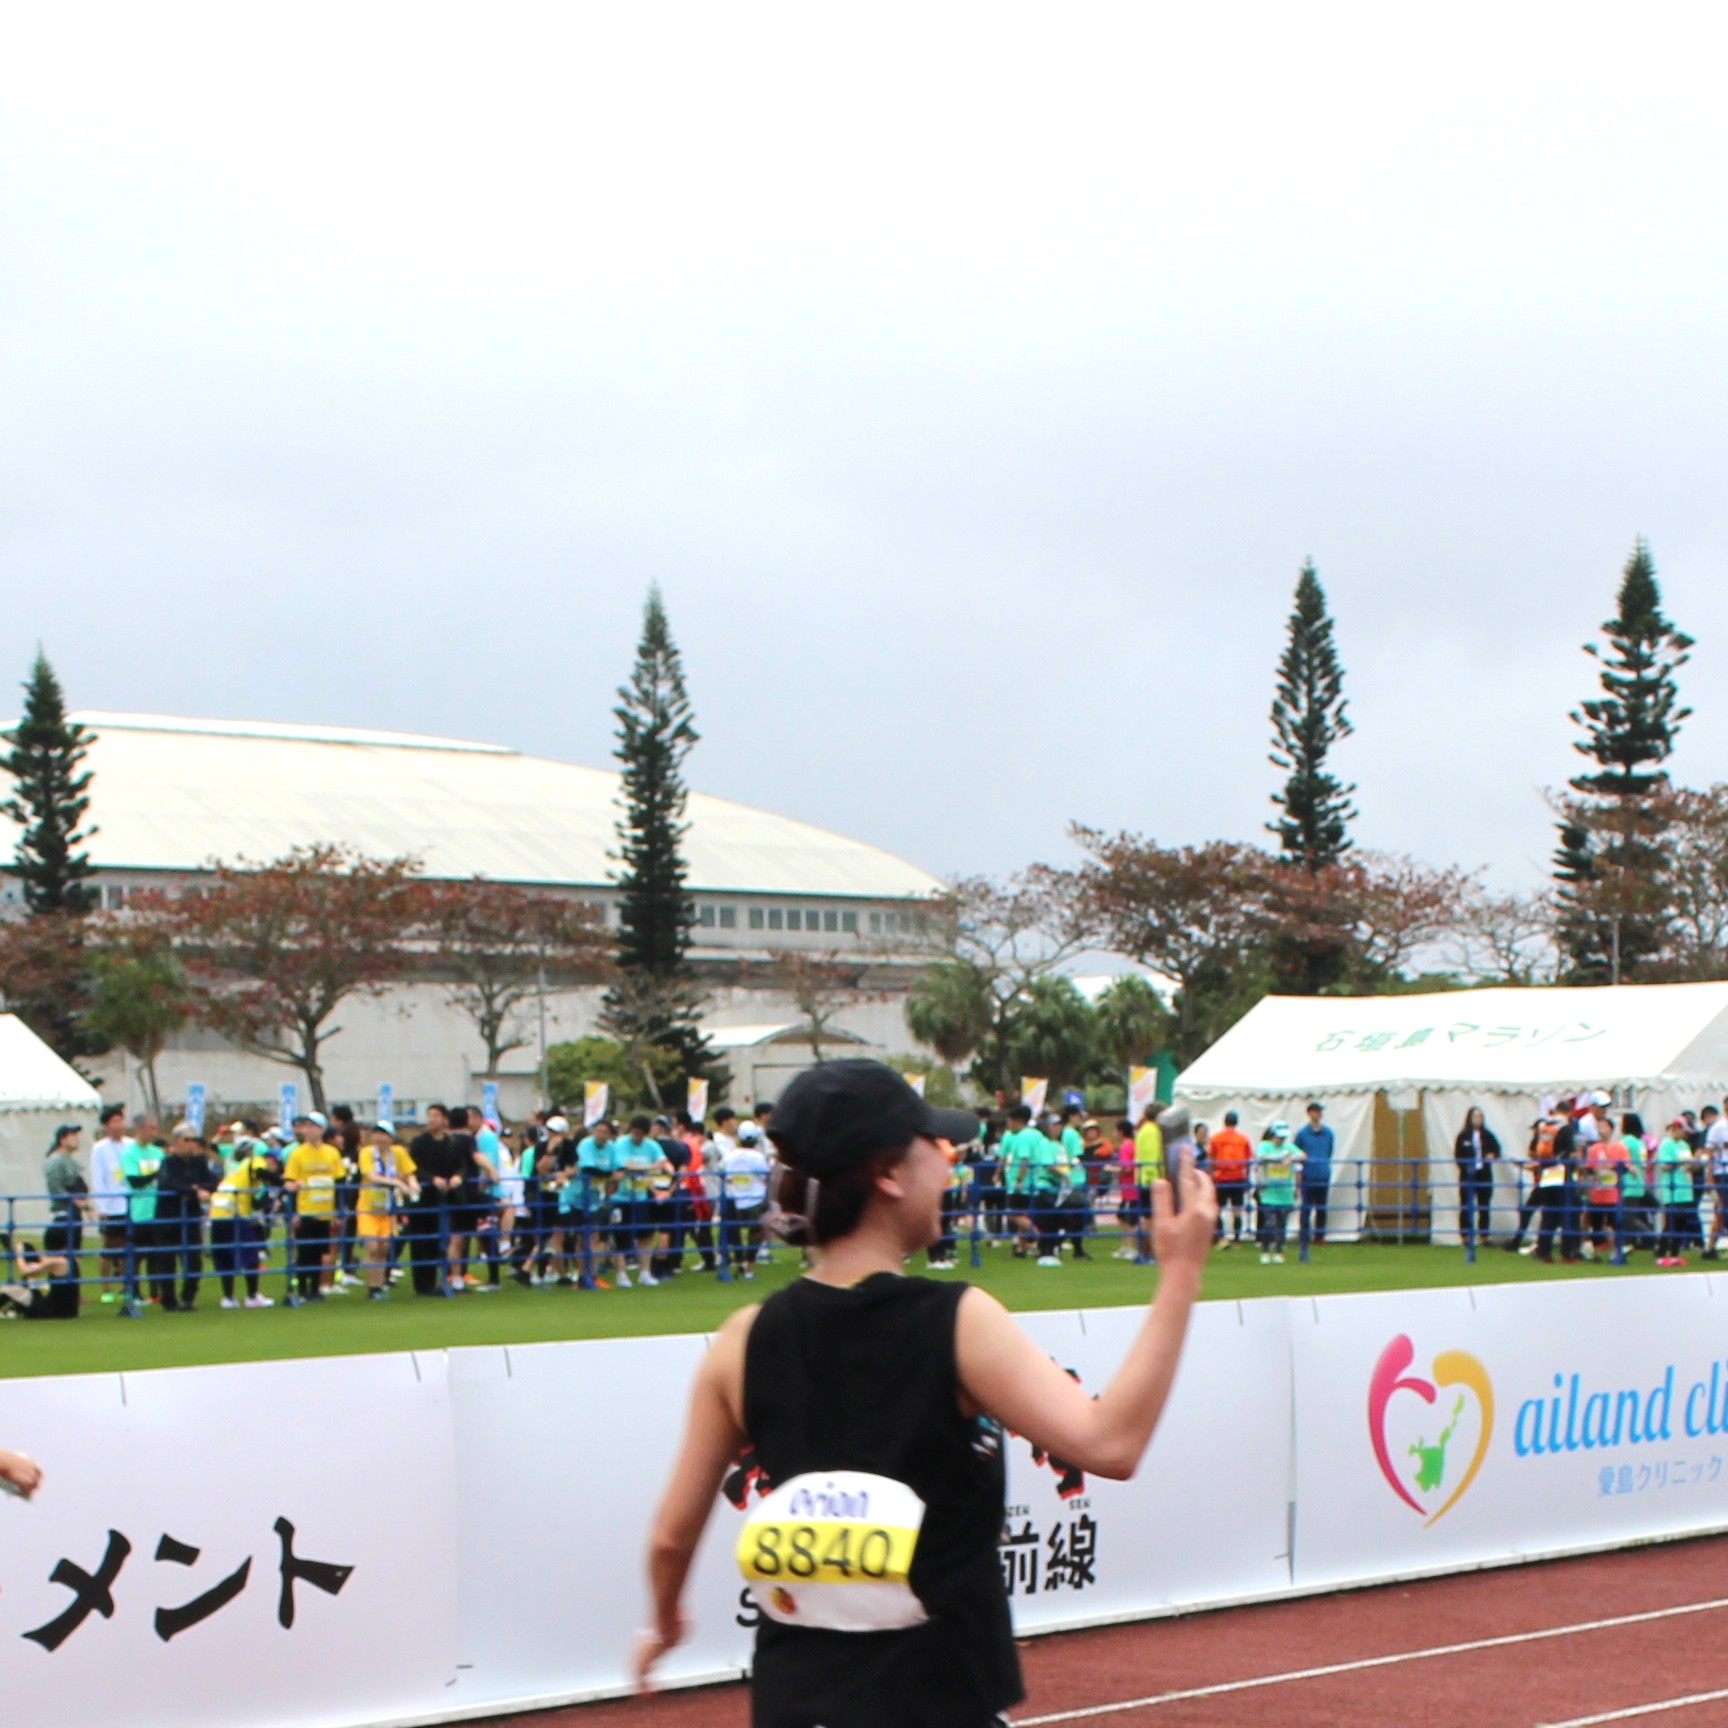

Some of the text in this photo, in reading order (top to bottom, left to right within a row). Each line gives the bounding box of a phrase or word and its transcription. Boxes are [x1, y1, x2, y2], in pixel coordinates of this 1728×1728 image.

[1514, 1364, 1675, 1457] ailand
[1598, 1455, 1723, 1497] 愛島クリニック
[752, 1526, 890, 1577] 8840
